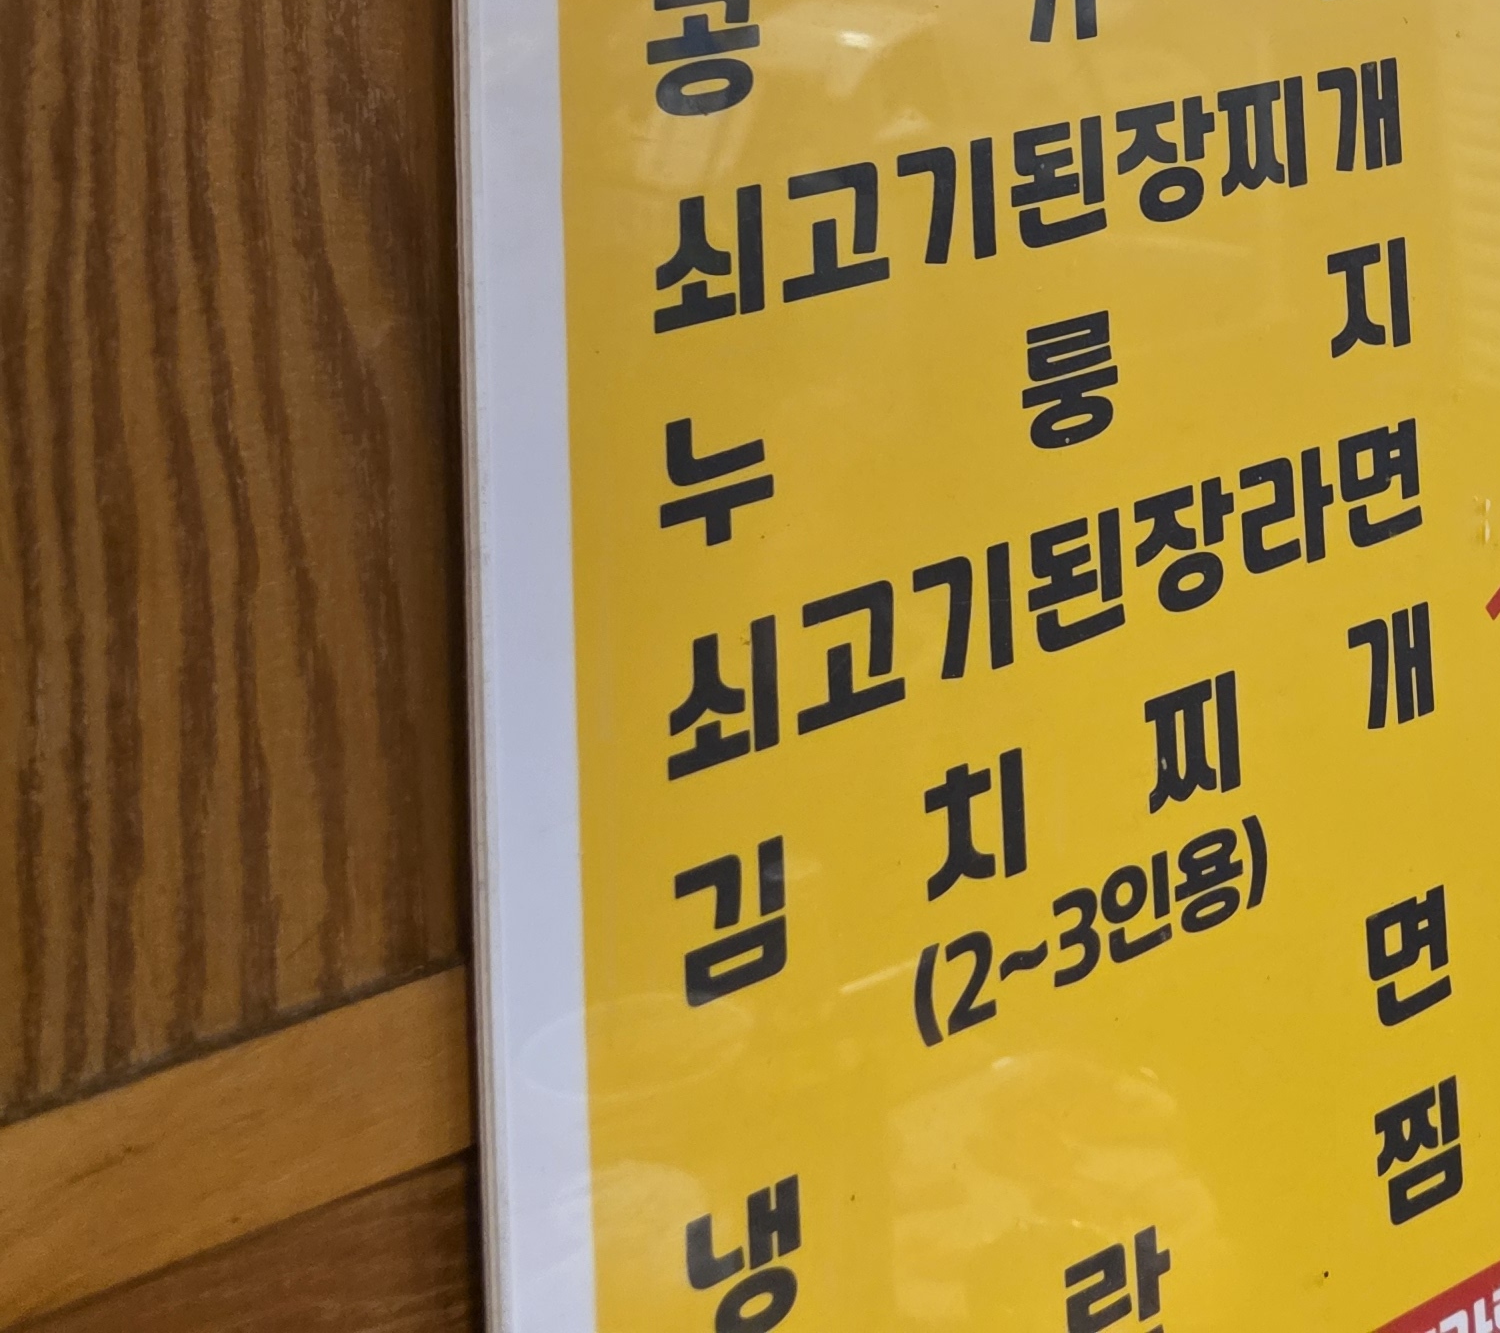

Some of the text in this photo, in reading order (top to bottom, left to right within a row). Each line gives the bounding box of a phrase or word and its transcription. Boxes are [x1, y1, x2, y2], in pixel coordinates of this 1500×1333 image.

[653, 57, 1403, 335] 쇠고기된장찌개
[667, 417, 1423, 781] 쇠고기된장라면
[913, 814, 1268, 1047] (2~3인용)
